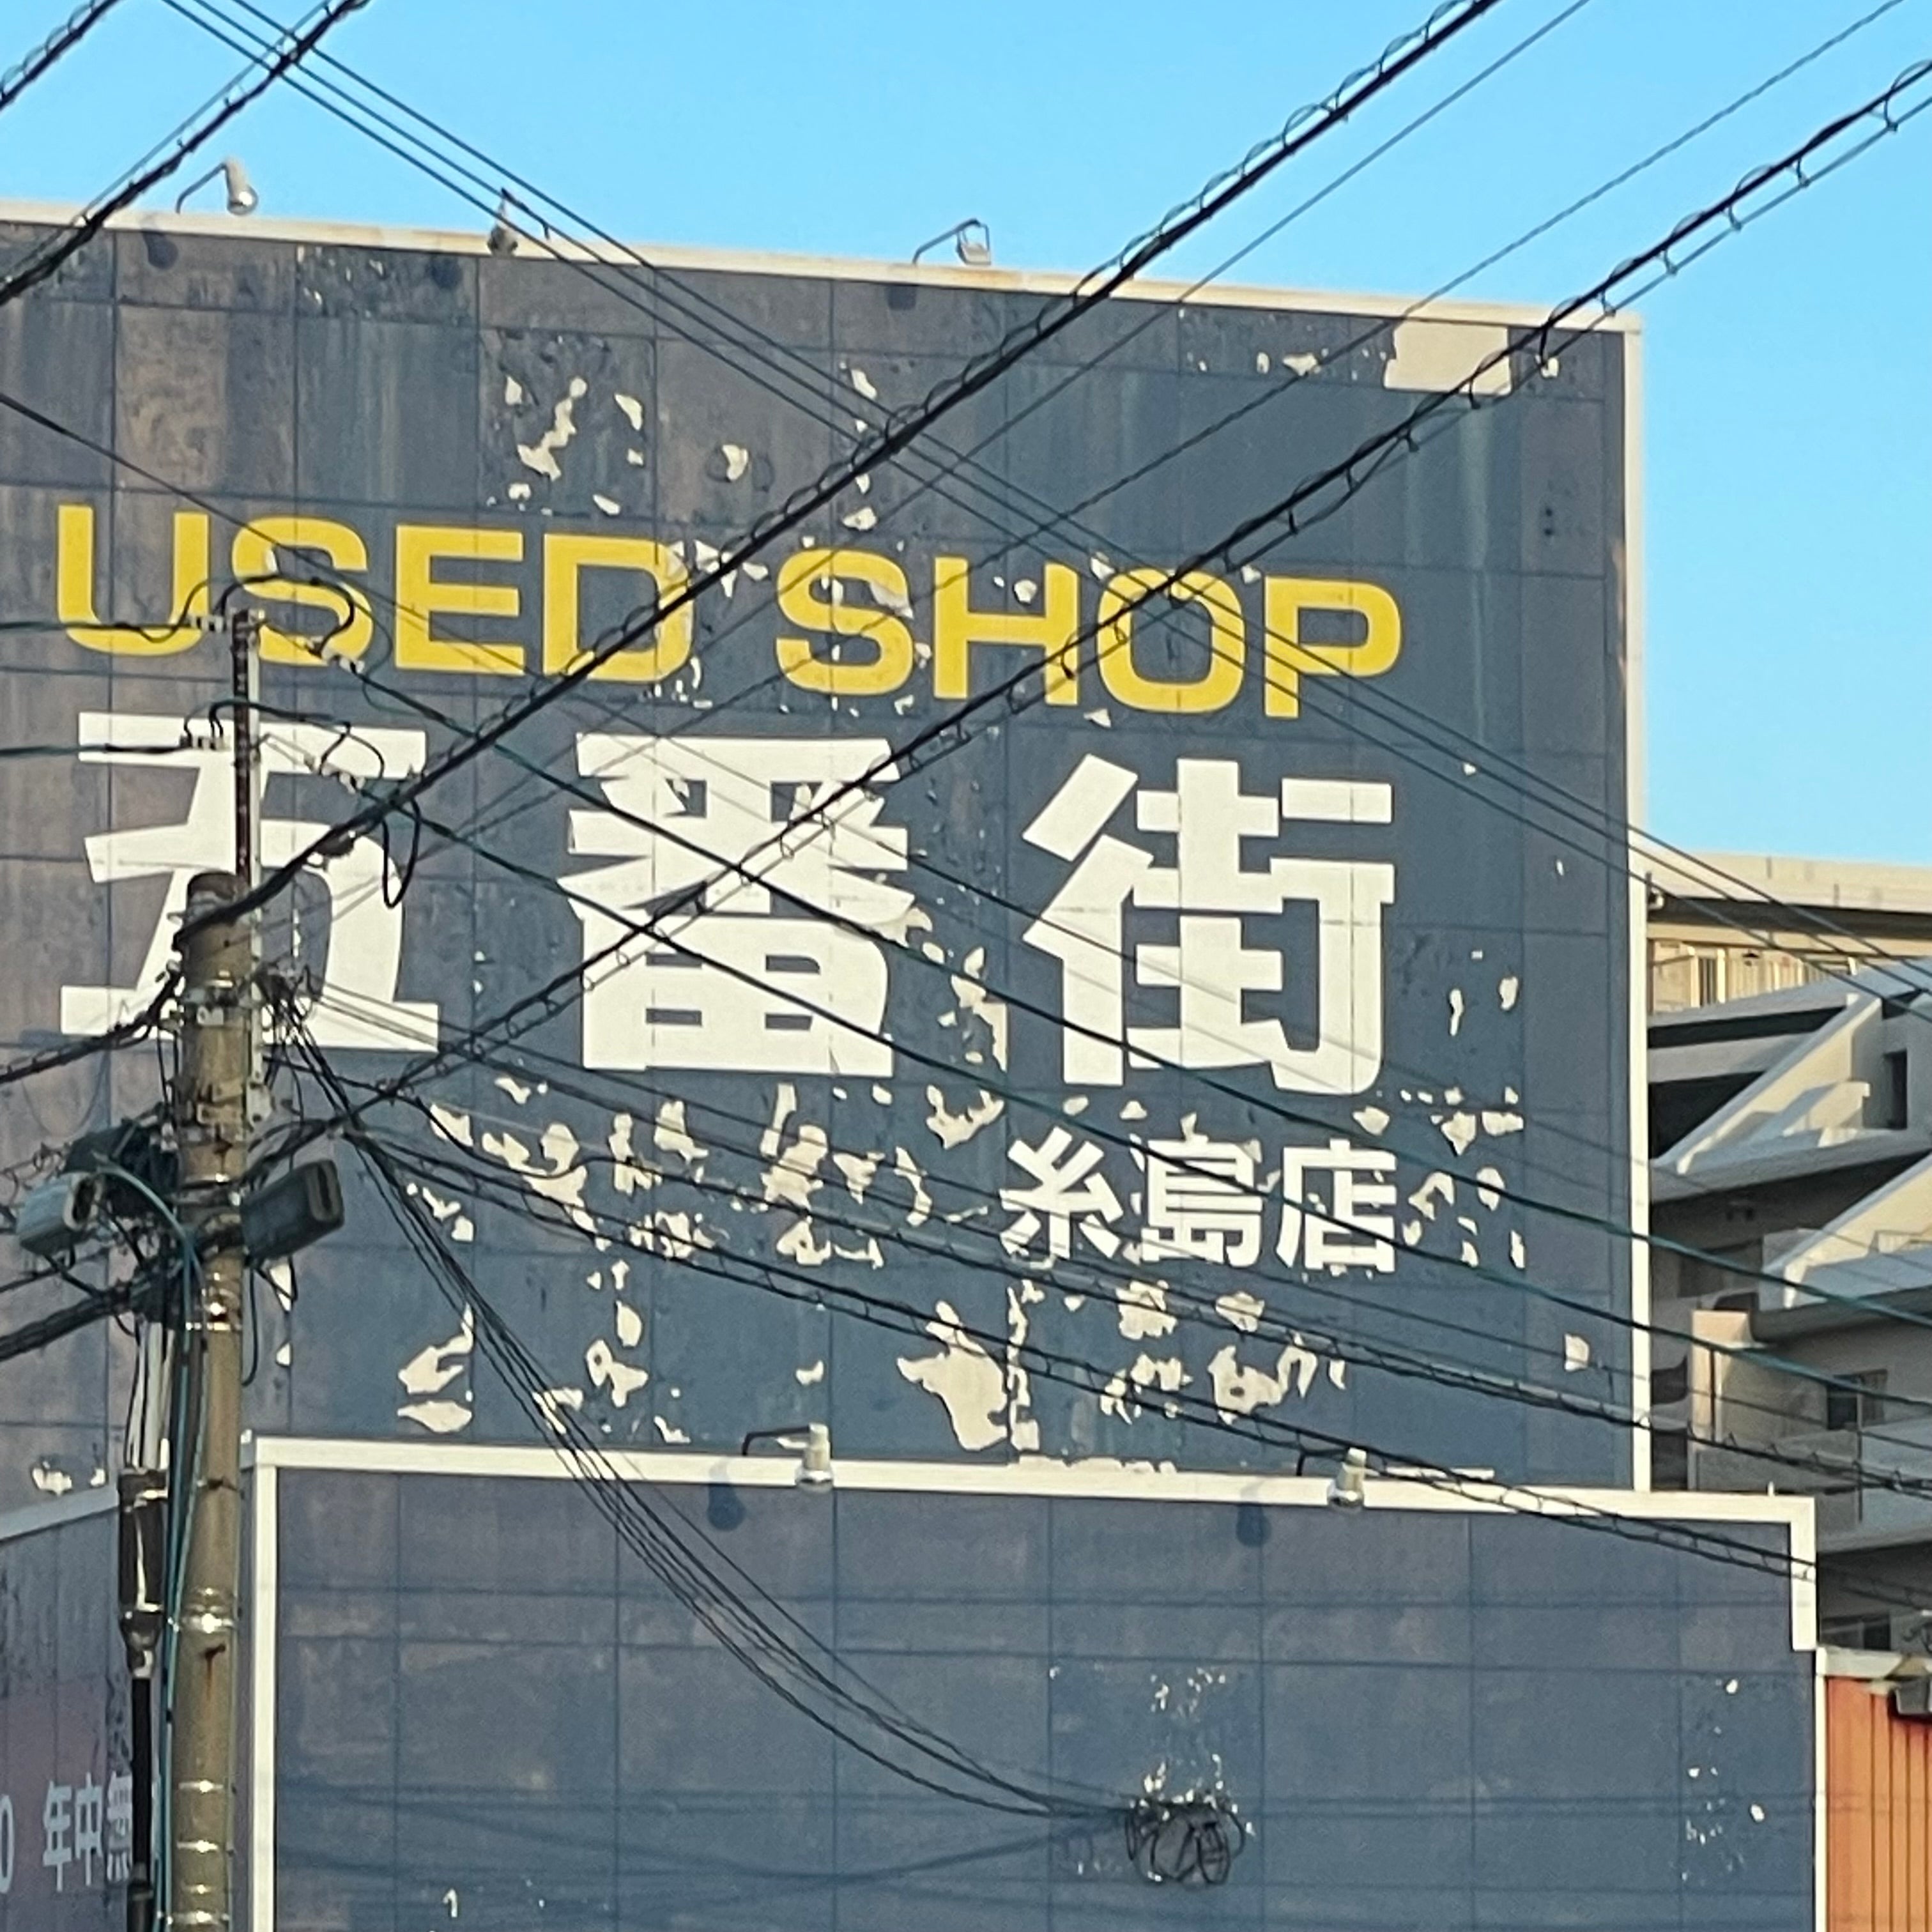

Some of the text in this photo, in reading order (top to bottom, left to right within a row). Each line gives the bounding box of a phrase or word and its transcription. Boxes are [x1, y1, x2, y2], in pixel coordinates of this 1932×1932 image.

[57, 505, 1402, 717] USED SHOP
[60, 710, 1395, 1096] 五番街
[999, 1127, 1398, 1274] 糸島店
